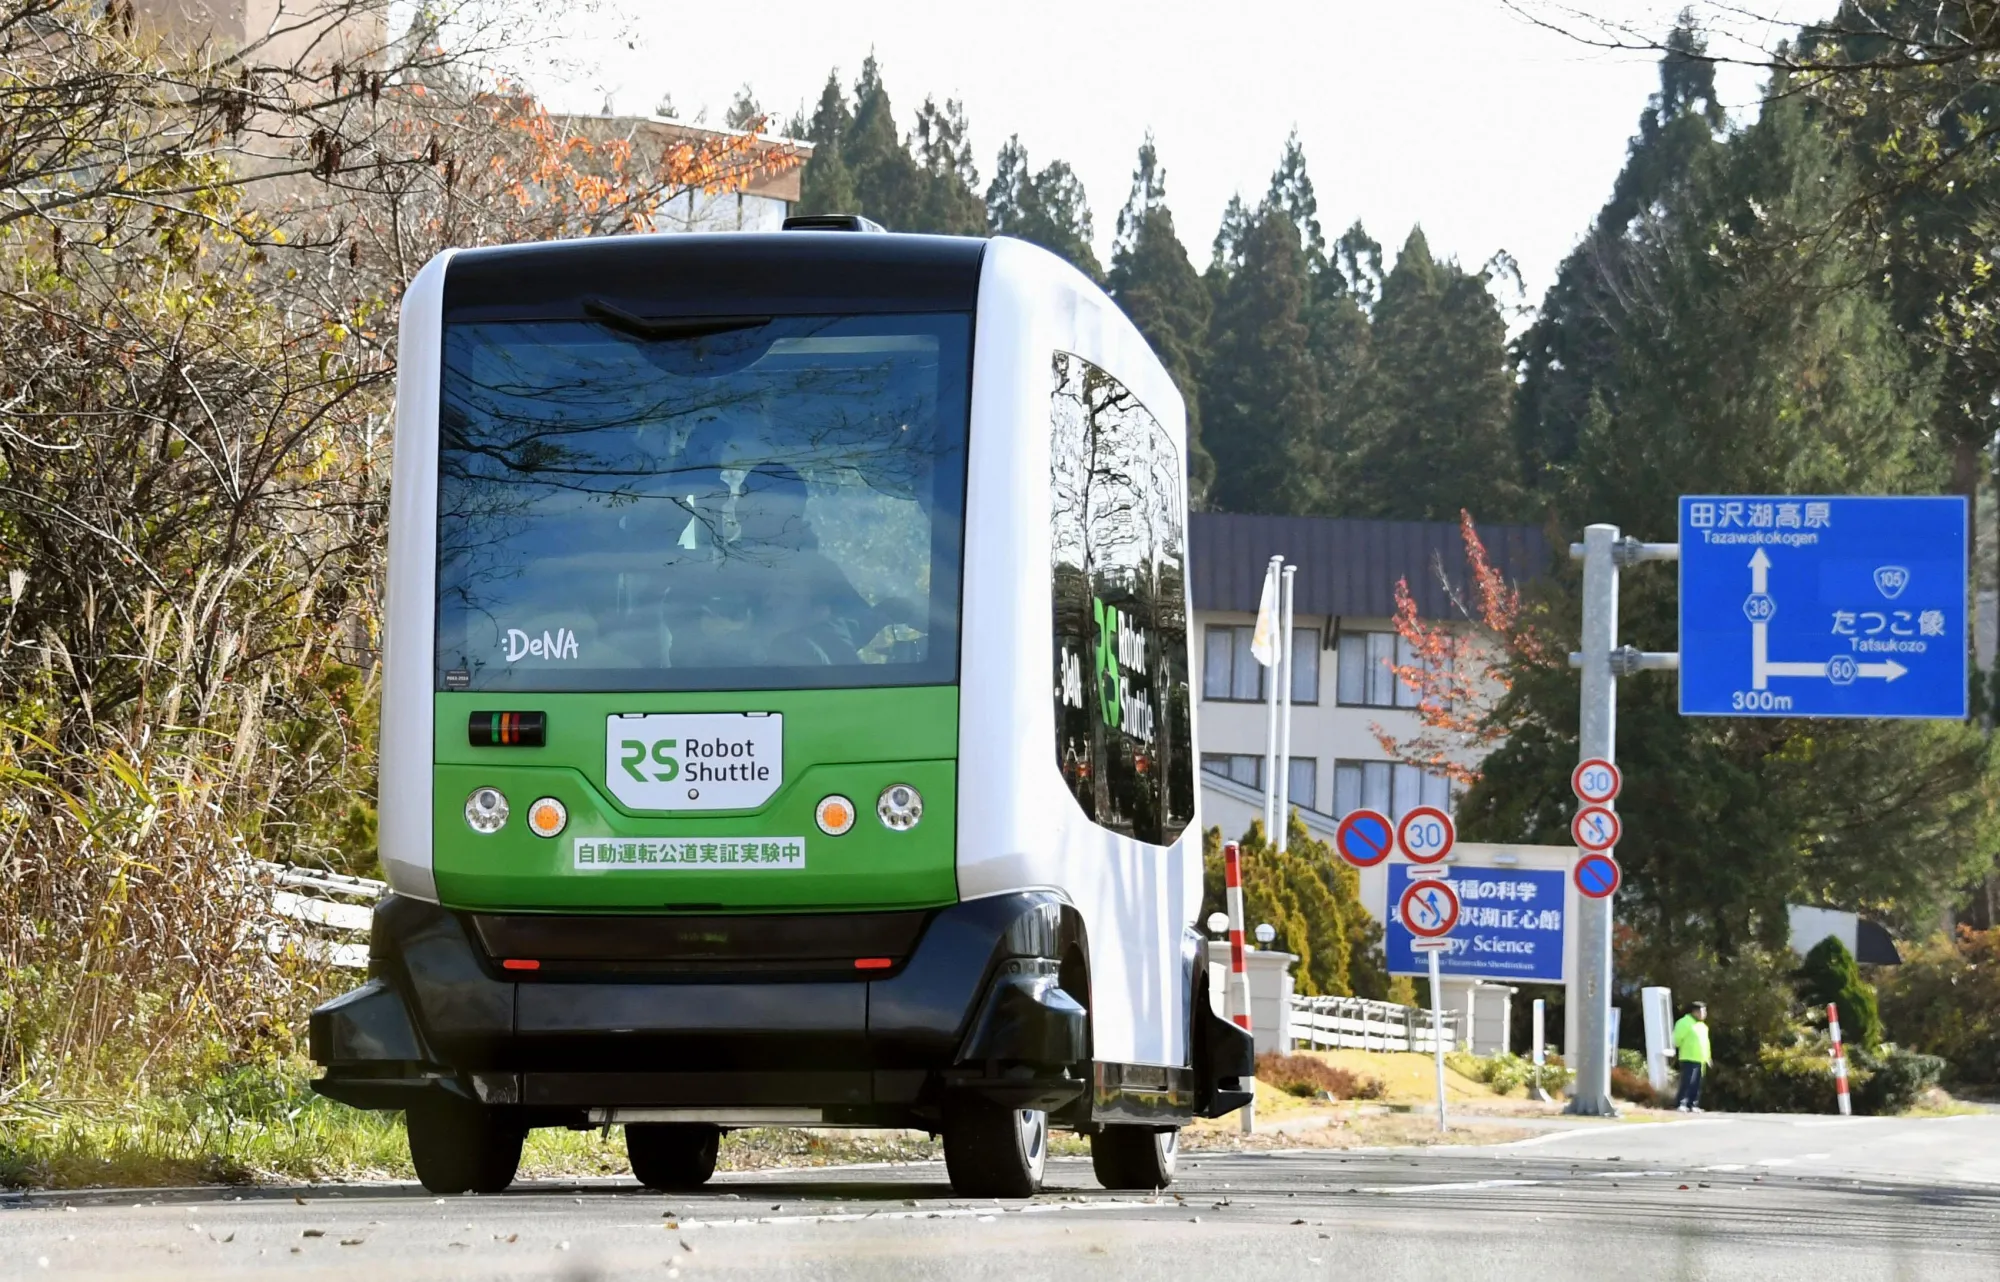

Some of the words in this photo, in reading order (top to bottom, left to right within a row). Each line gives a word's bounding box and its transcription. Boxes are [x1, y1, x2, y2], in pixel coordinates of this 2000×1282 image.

[1690, 502, 1831, 529] 田沢湖高原
[1702, 530, 1819, 548] Tazawakokogen
[1880, 572, 1901, 588] 105
[1749, 600, 1768, 617] 38
[1831, 610, 1946, 637] たつこ像
[1118, 610, 1146, 676] Robot
[1849, 637, 1926, 653] Tatsukozo
[1831, 662, 1850, 678] 60
[1732, 691, 1793, 710] 300m
[1120, 677, 1155, 745] Shuttle
[620, 739, 679, 783] RS
[686, 739, 755, 759] Robot
[685, 762, 770, 783] Shuttle
[1583, 771, 1609, 791] 30
[1409, 823, 1441, 848] 30
[578, 843, 801, 864] 自動運転公道実証実験中
[1473, 935, 1536, 955] Science
